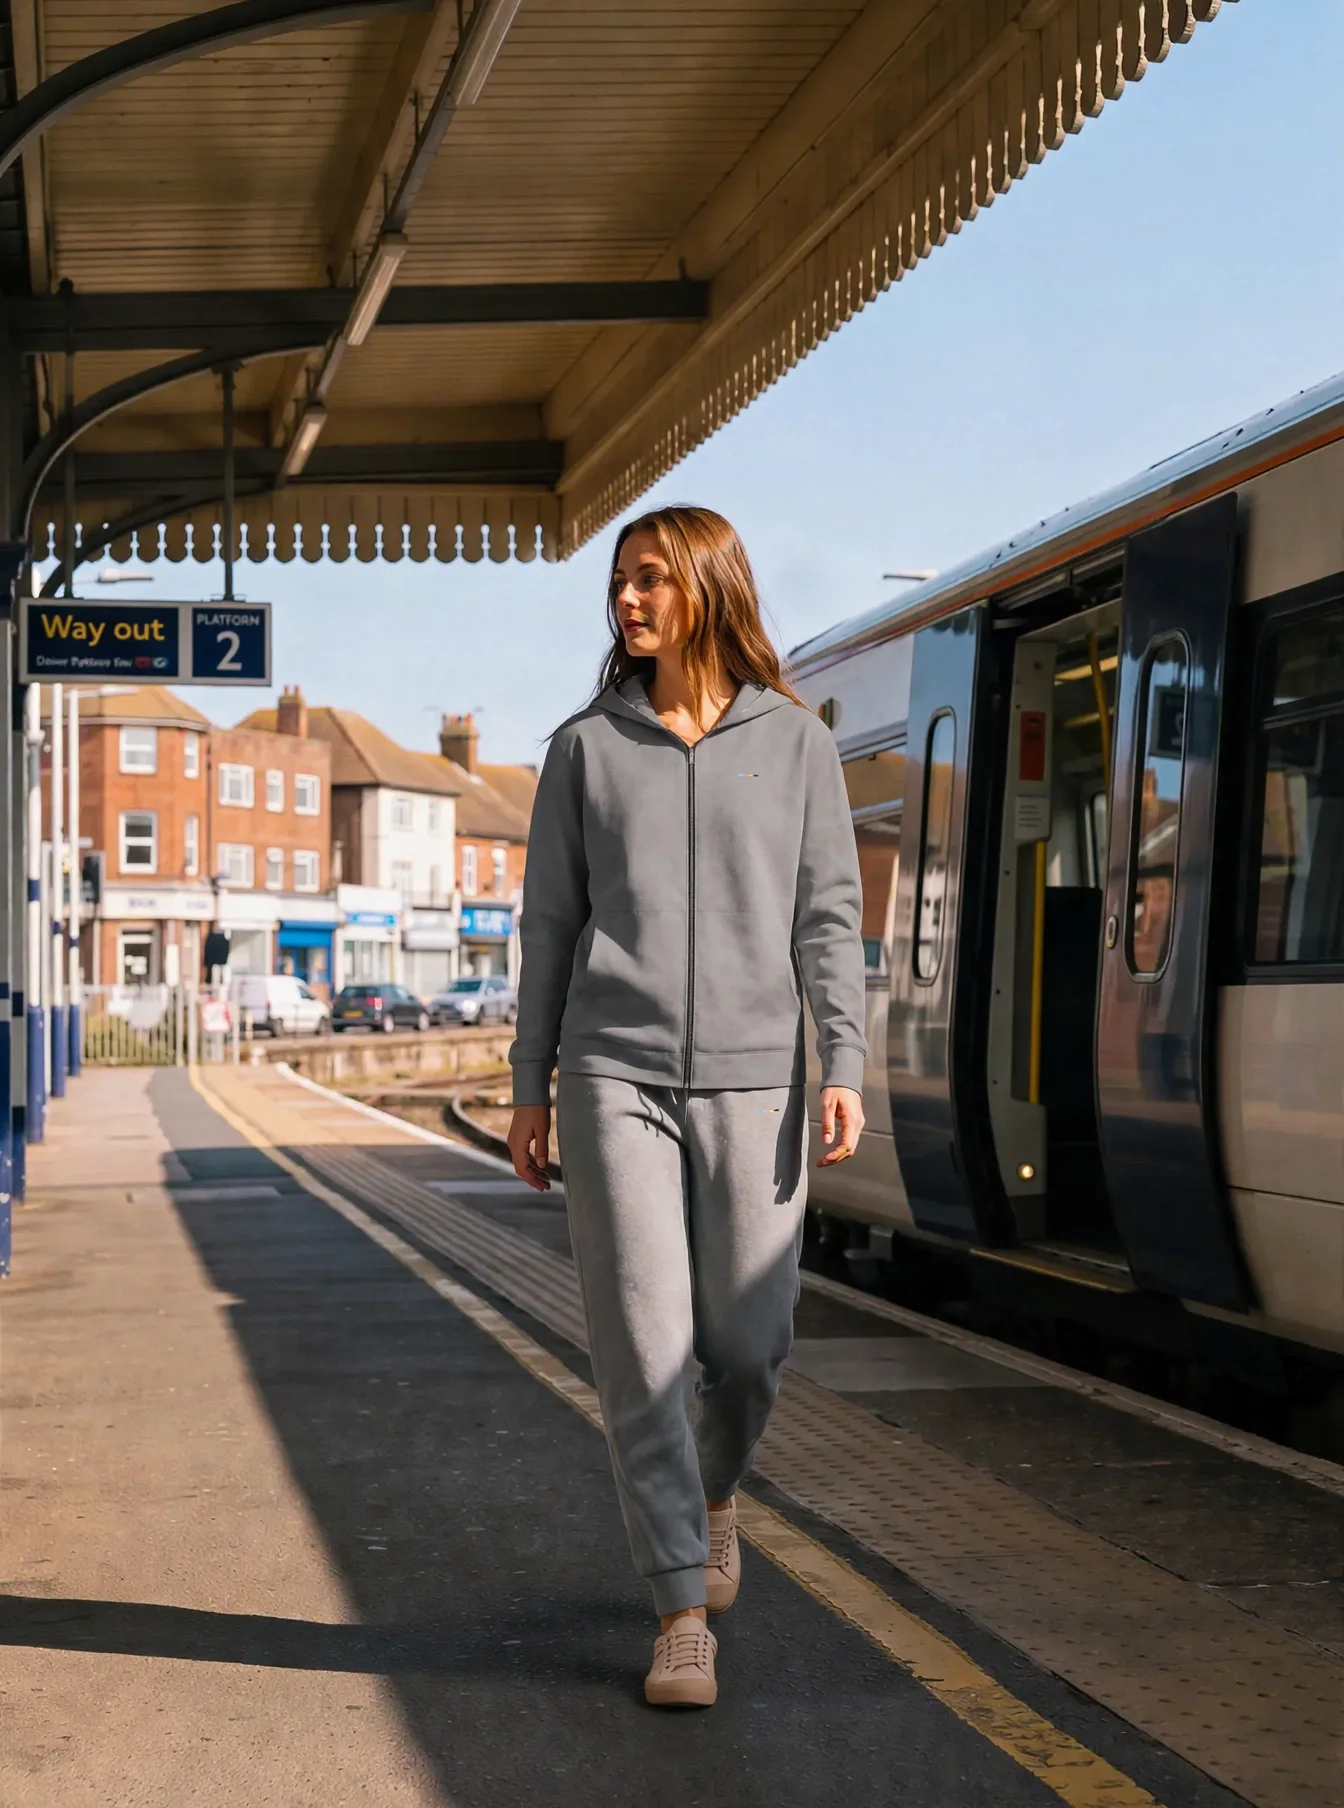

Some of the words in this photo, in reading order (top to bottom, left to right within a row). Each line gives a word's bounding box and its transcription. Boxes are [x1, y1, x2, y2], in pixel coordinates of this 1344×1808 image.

[41, 614, 105, 647] Way
[114, 619, 165, 641] out
[216, 630, 242, 671] 2
